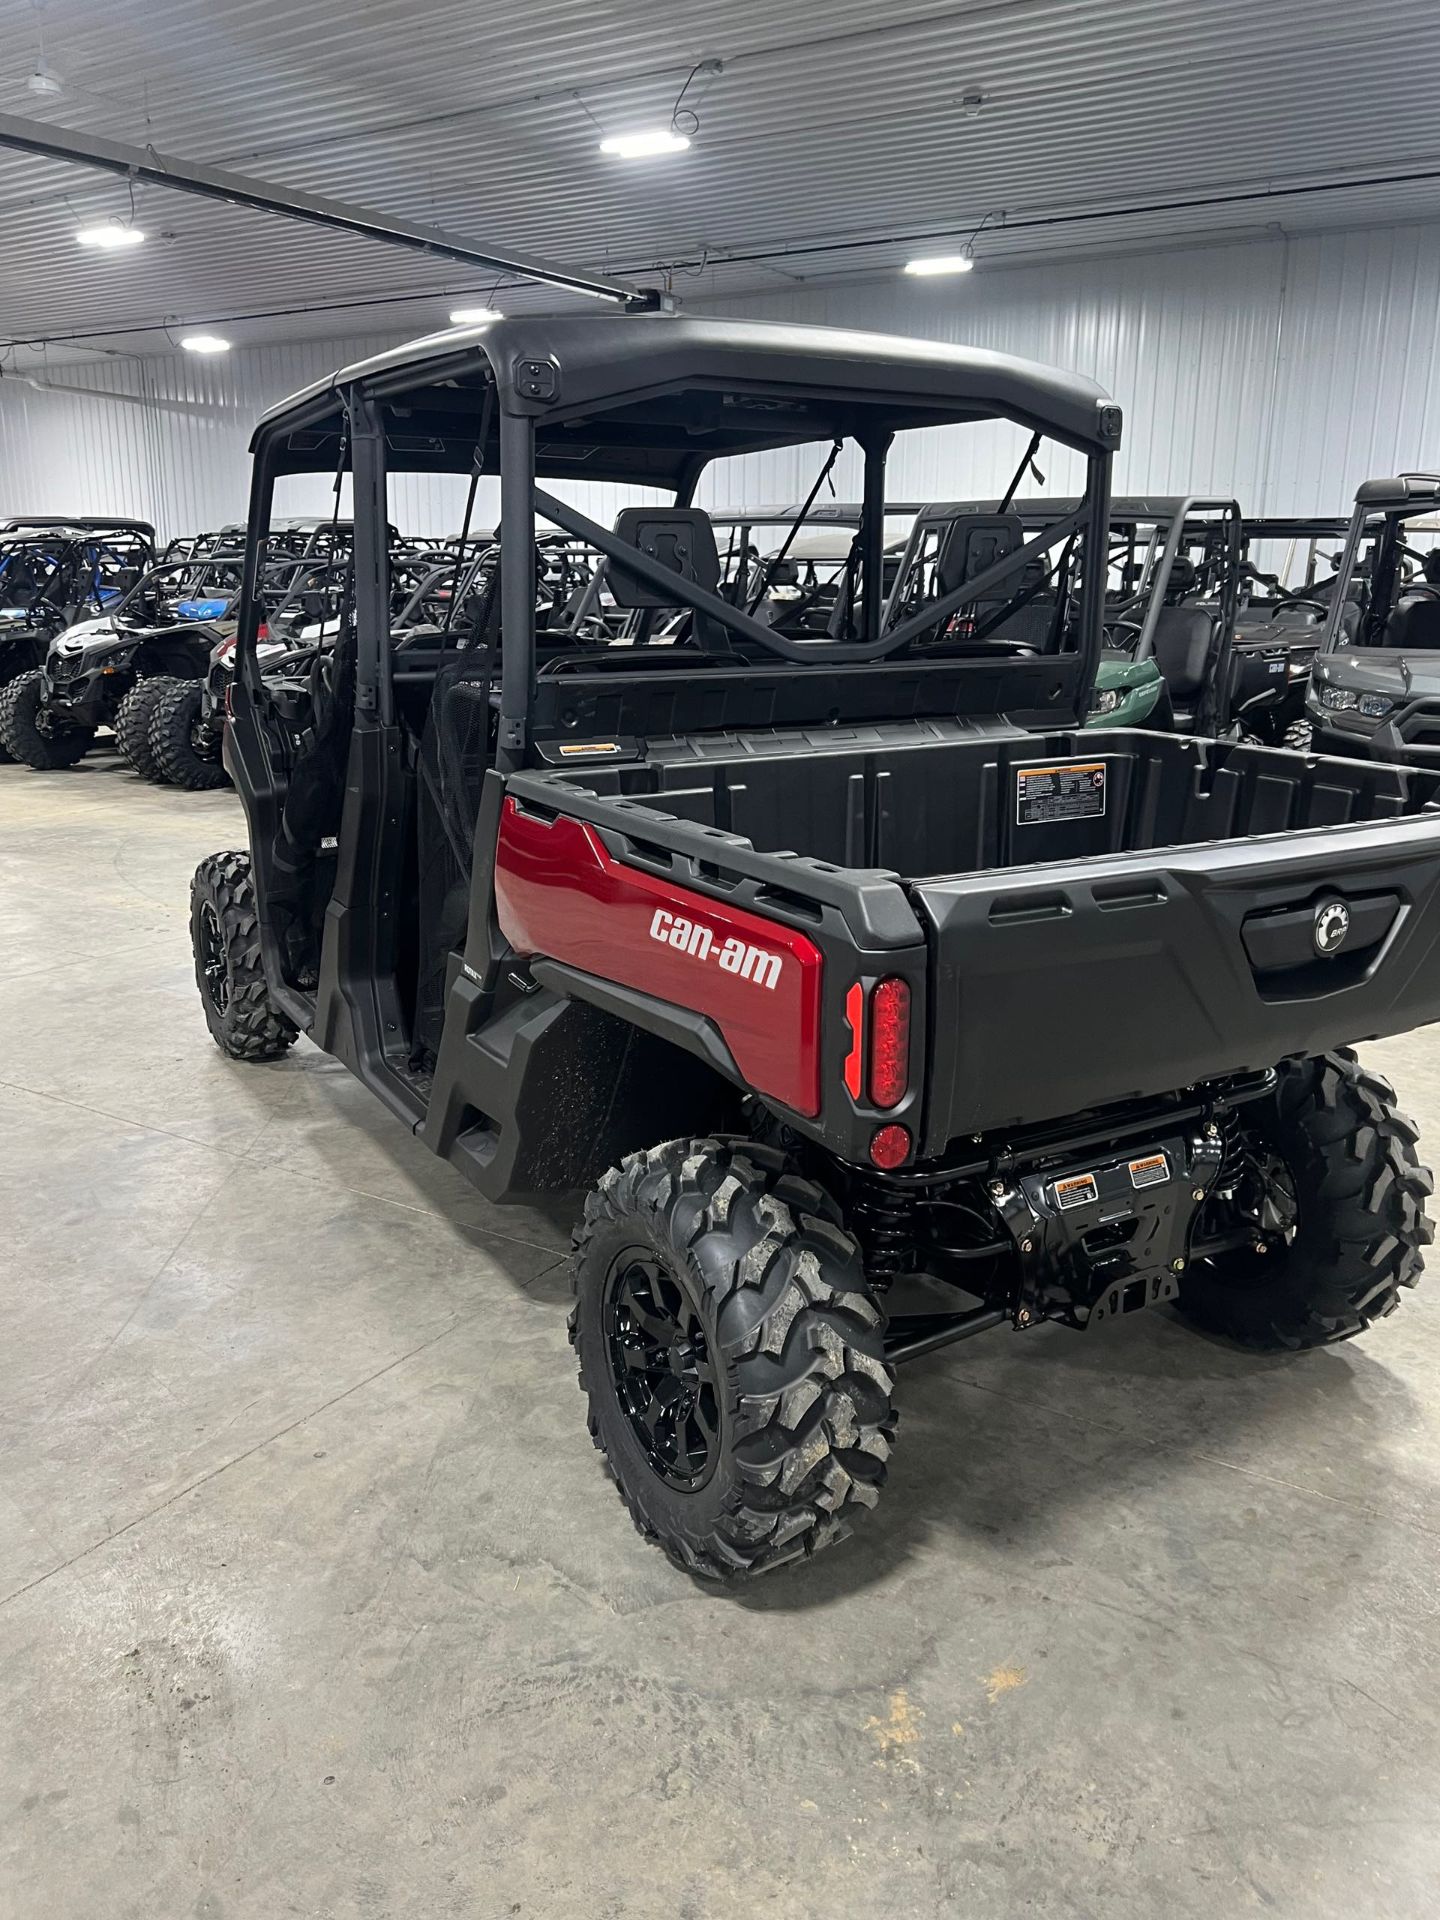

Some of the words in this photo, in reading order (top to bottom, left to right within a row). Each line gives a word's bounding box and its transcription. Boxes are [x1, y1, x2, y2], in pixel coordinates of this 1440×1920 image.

[1330, 926, 1348, 938] BRP
[649, 908, 783, 990] can-am
[1139, 1159, 1159, 1168] WARNING
[1067, 1178, 1088, 1189] WARNING
